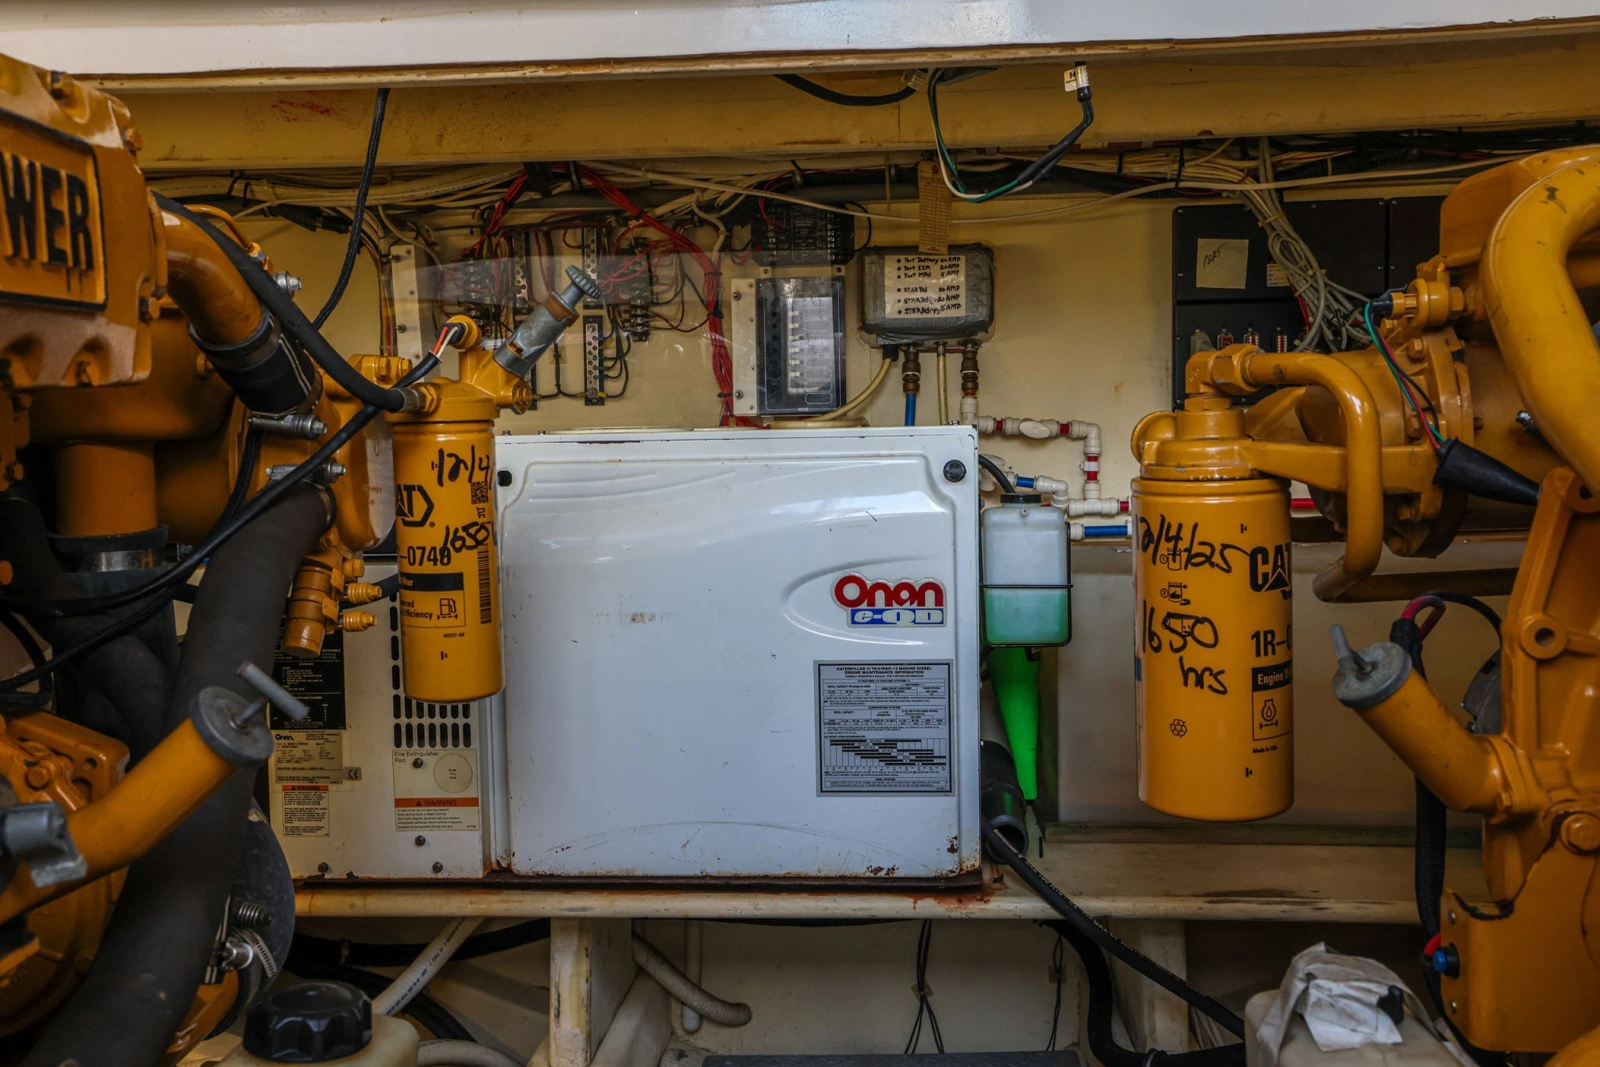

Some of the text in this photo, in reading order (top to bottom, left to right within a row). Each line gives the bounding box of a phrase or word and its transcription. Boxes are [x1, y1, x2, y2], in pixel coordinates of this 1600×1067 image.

[834, 574, 944, 608] Onan
[1178, 656, 1228, 695] hrs
[1258, 671, 1284, 686] Engine
